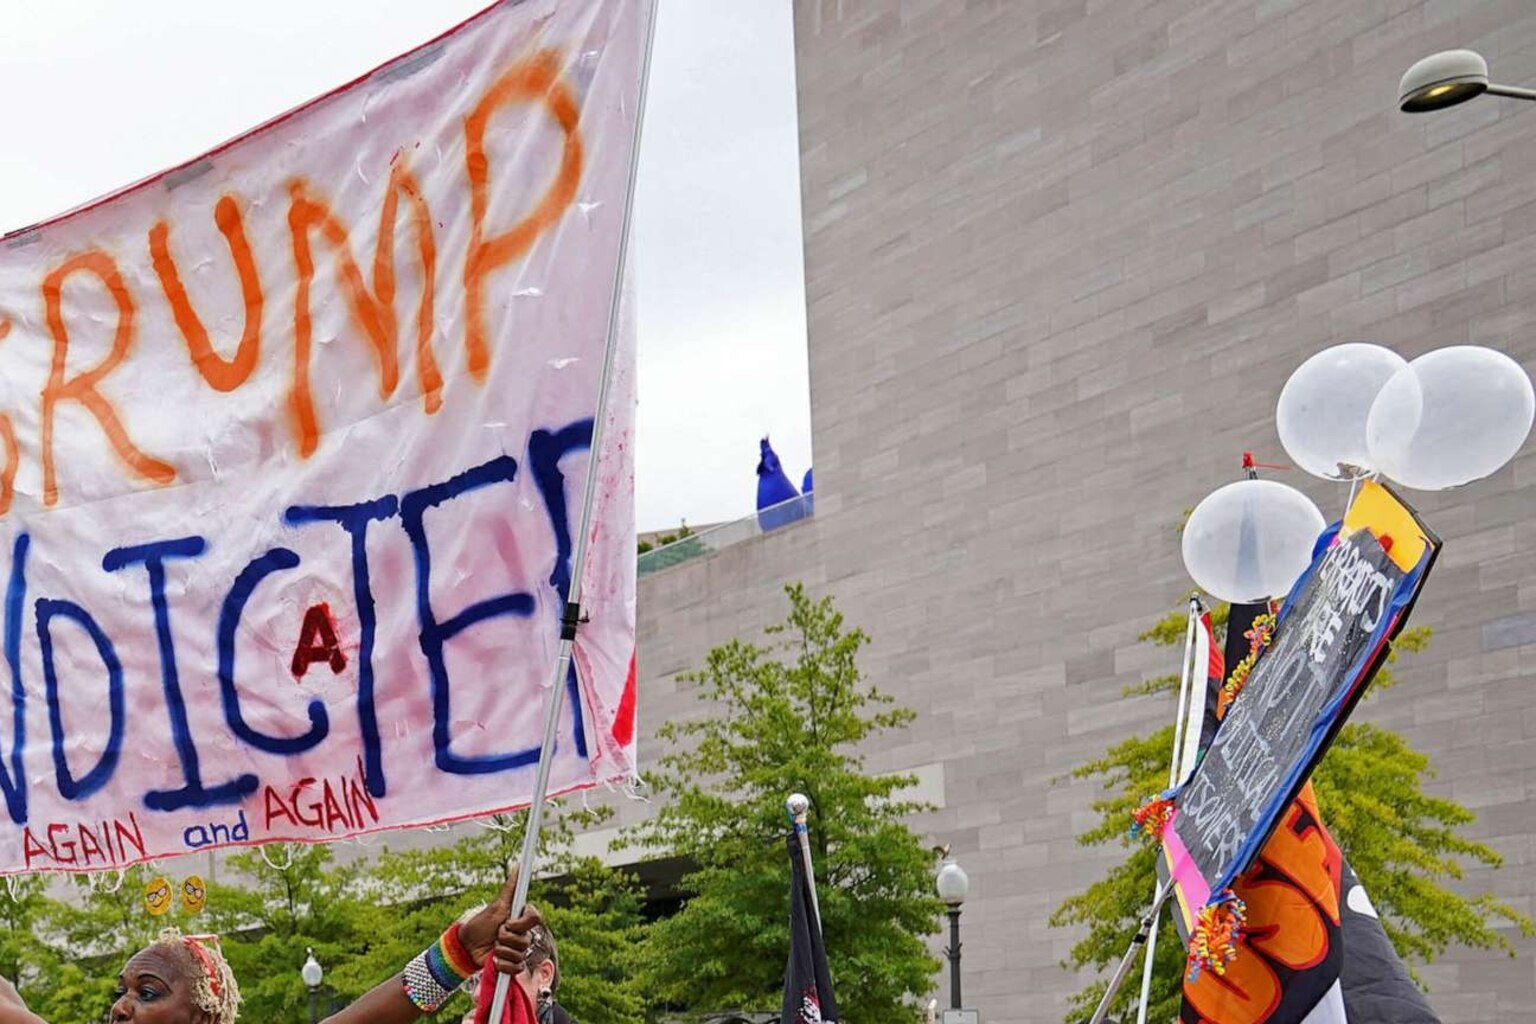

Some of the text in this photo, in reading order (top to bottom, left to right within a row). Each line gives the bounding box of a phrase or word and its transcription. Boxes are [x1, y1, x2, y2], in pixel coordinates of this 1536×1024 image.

[290, 601, 348, 681] A
[23, 755, 381, 870] AGAIN and AGAIN
